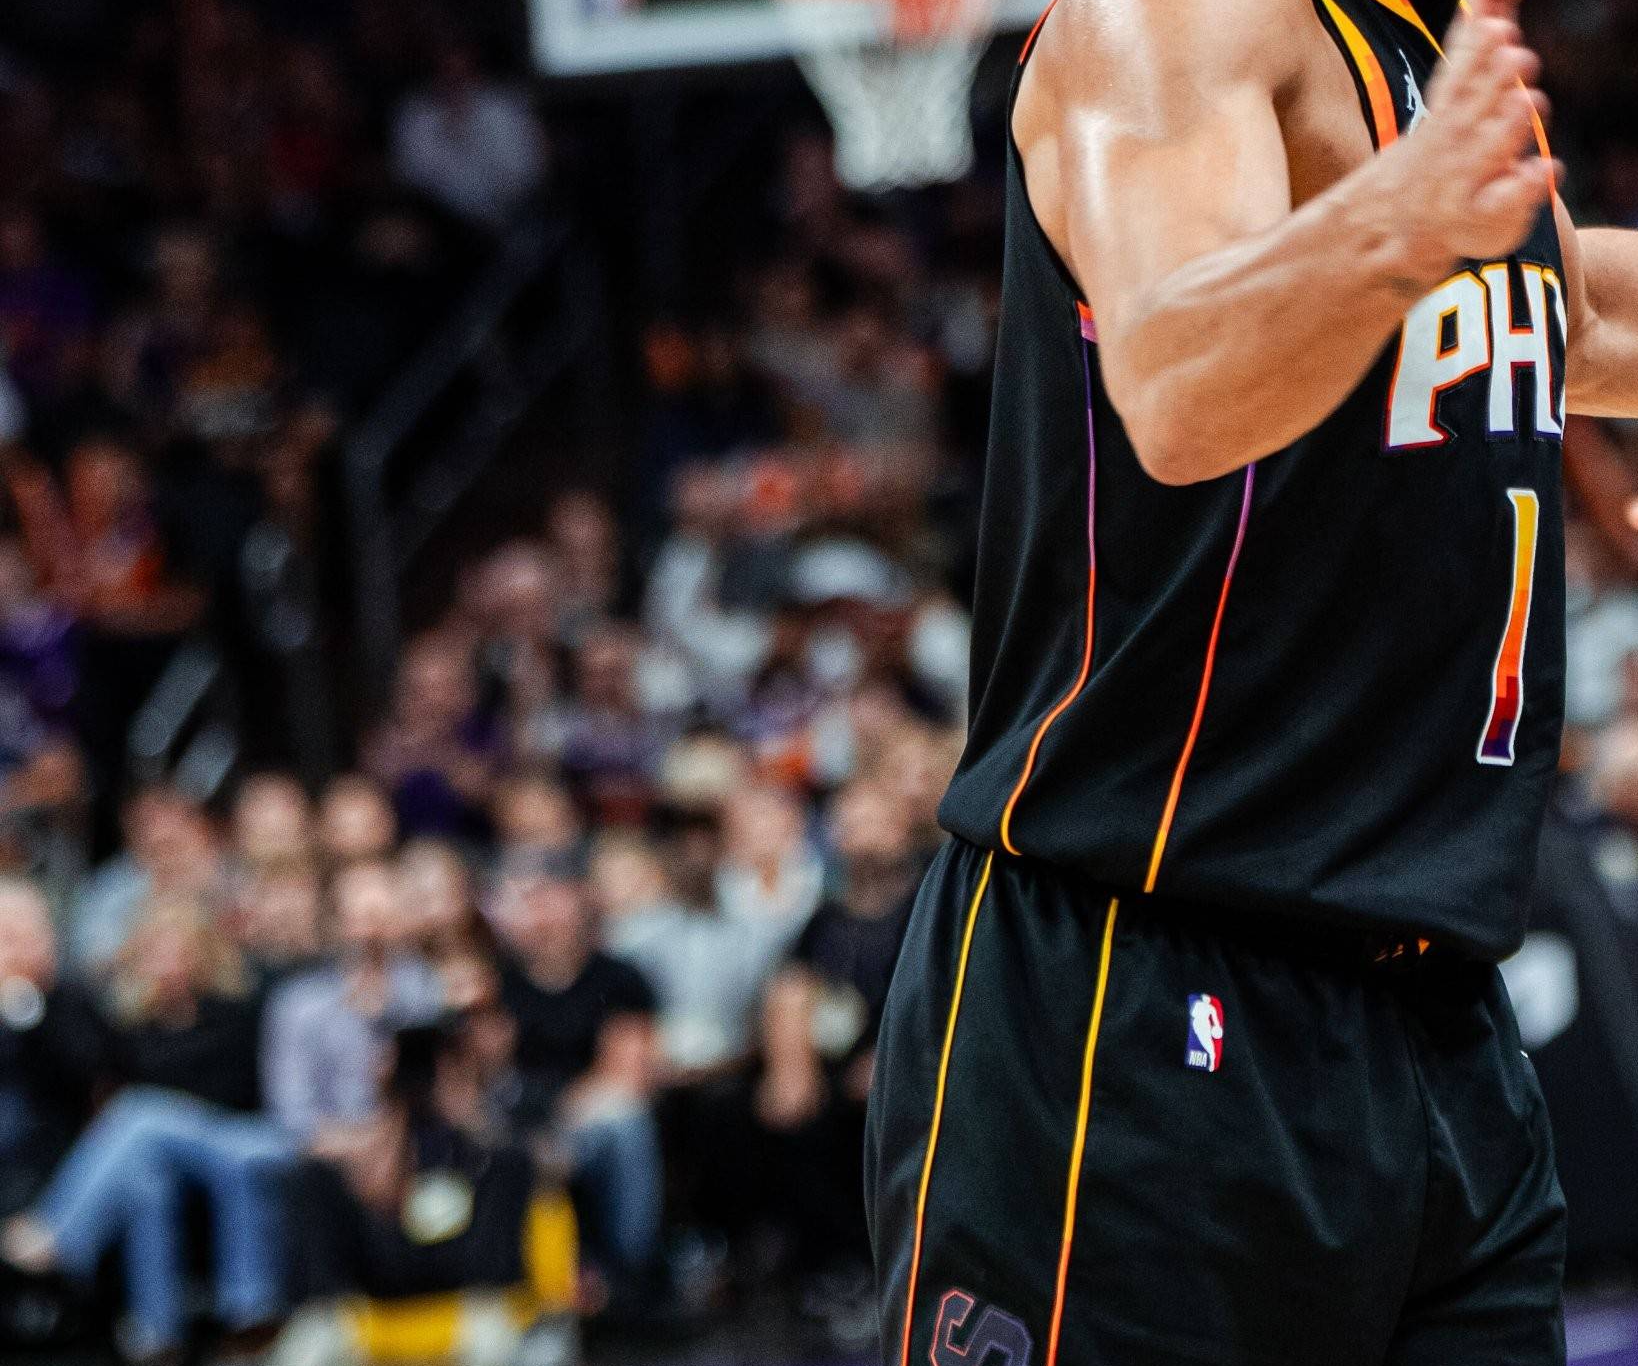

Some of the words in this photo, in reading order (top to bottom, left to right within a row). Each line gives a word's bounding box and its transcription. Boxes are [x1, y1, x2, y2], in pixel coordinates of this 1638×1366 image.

[1381, 260, 1567, 453] PH
[1475, 488, 1540, 766] 1
[1189, 1051, 1208, 1067] NBA
